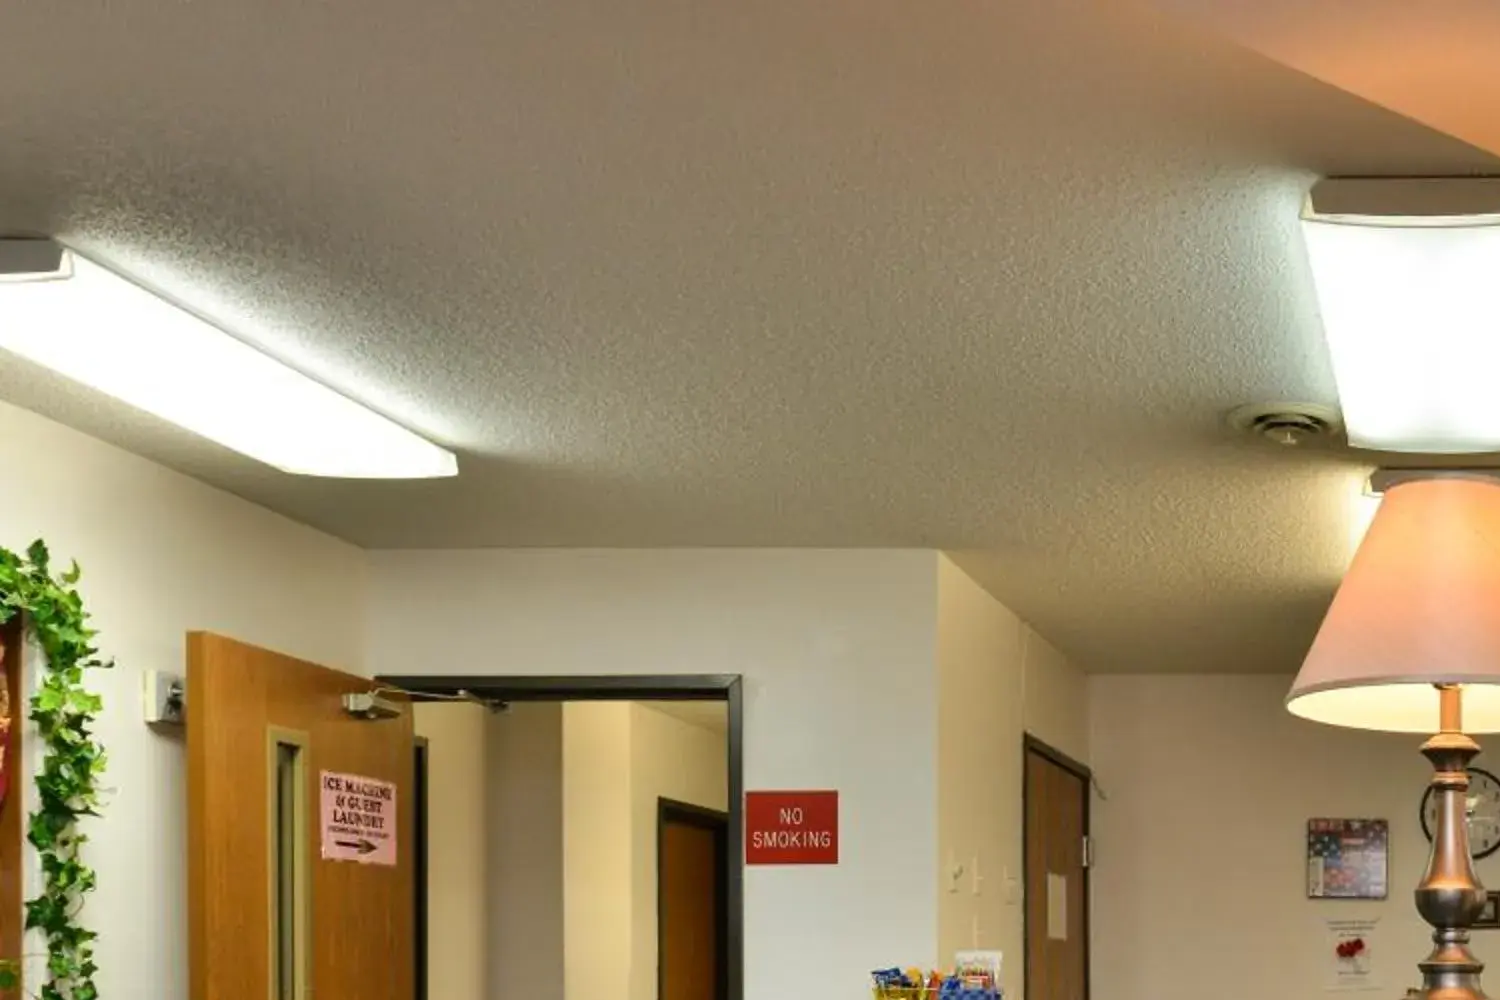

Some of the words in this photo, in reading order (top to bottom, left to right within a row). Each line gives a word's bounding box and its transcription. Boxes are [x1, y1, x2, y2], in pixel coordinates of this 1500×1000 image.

[323, 776, 341, 791] ICE
[345, 780, 392, 800] MACHINE
[348, 796, 382, 813] GUEST
[333, 809, 385, 829] LAUNDRY
[780, 807, 803, 825] NO
[752, 831, 831, 849] SMOKING
